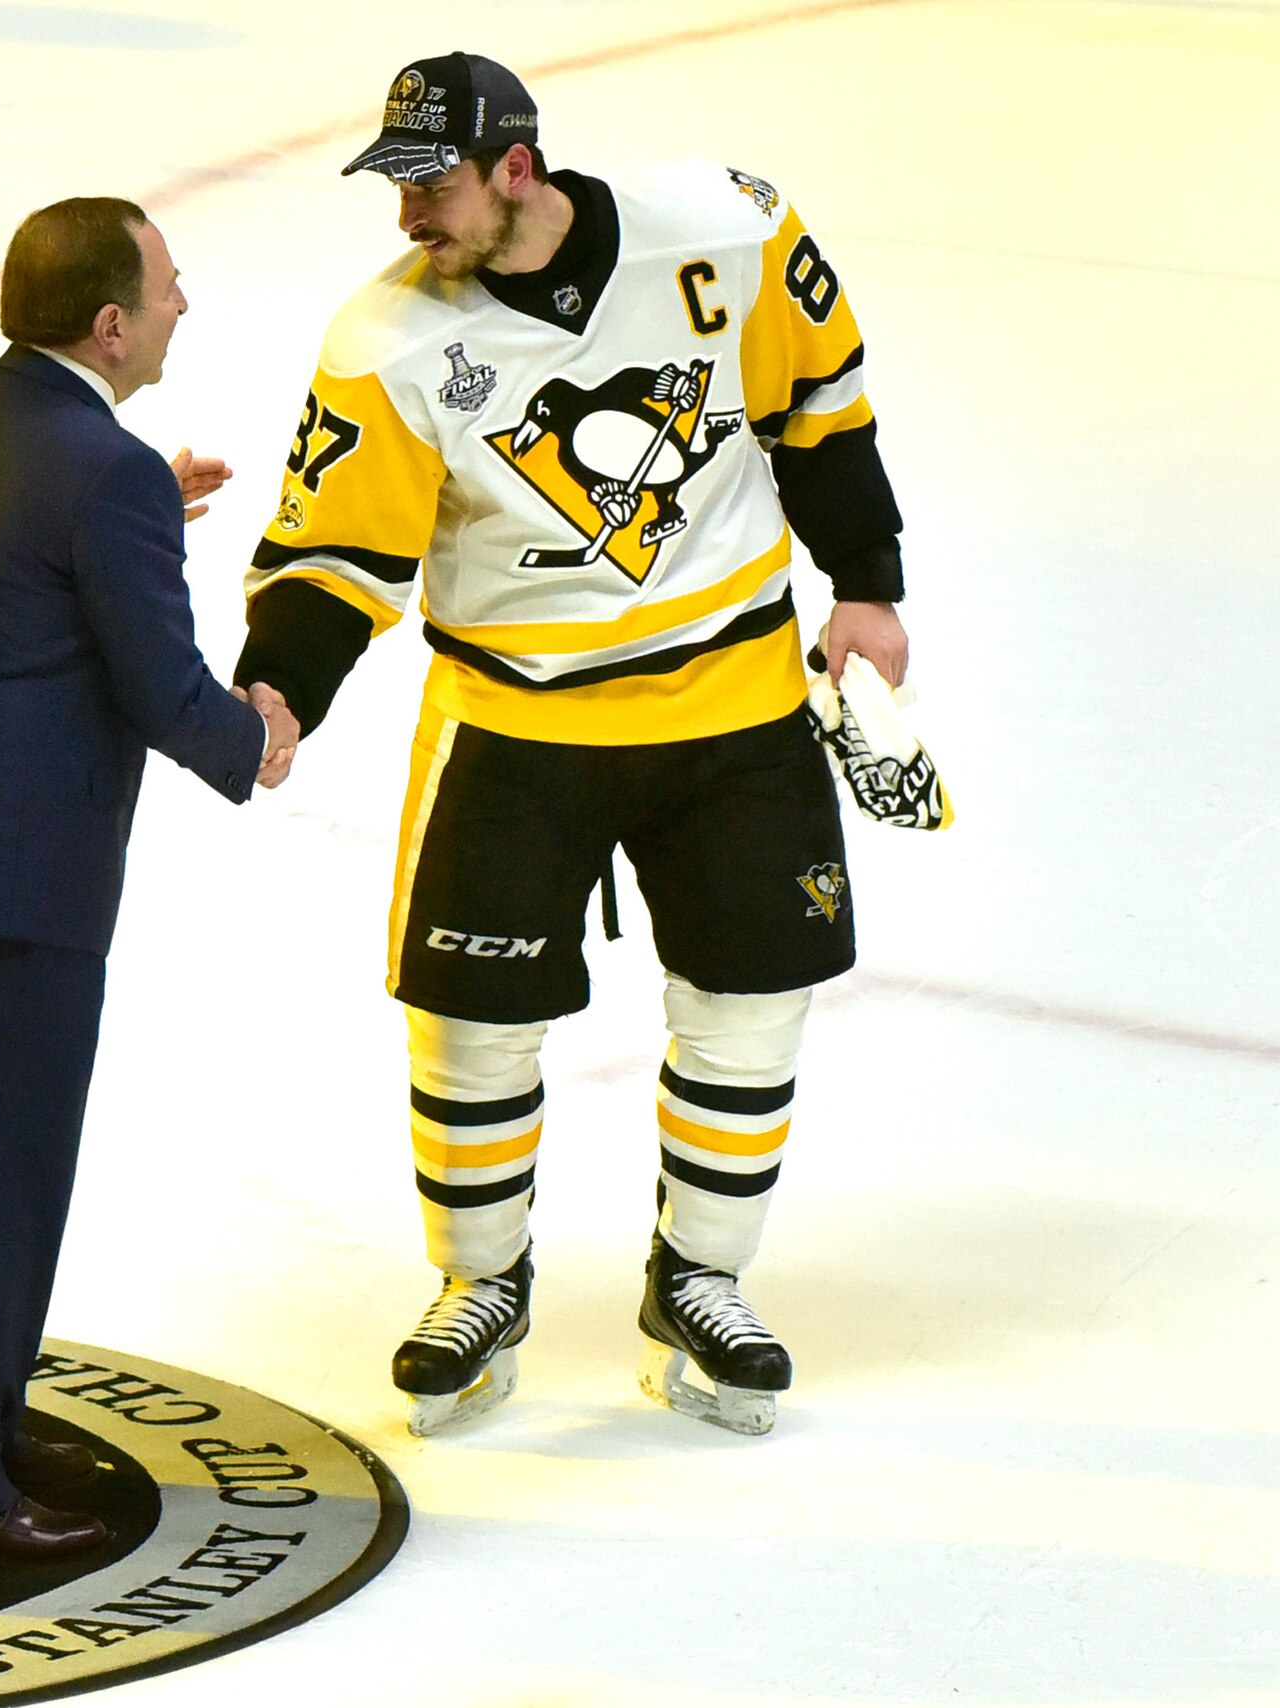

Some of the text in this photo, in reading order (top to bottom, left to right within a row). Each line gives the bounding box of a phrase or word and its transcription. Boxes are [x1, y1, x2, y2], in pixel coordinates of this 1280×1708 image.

[420, 102, 447, 114] CUP
[474, 96, 486, 139] Reebok
[676, 258, 730, 339] C
[441, 366, 496, 401] FINAL
[425, 925, 548, 958] CCM
[181, 1438, 318, 1508] CUP
